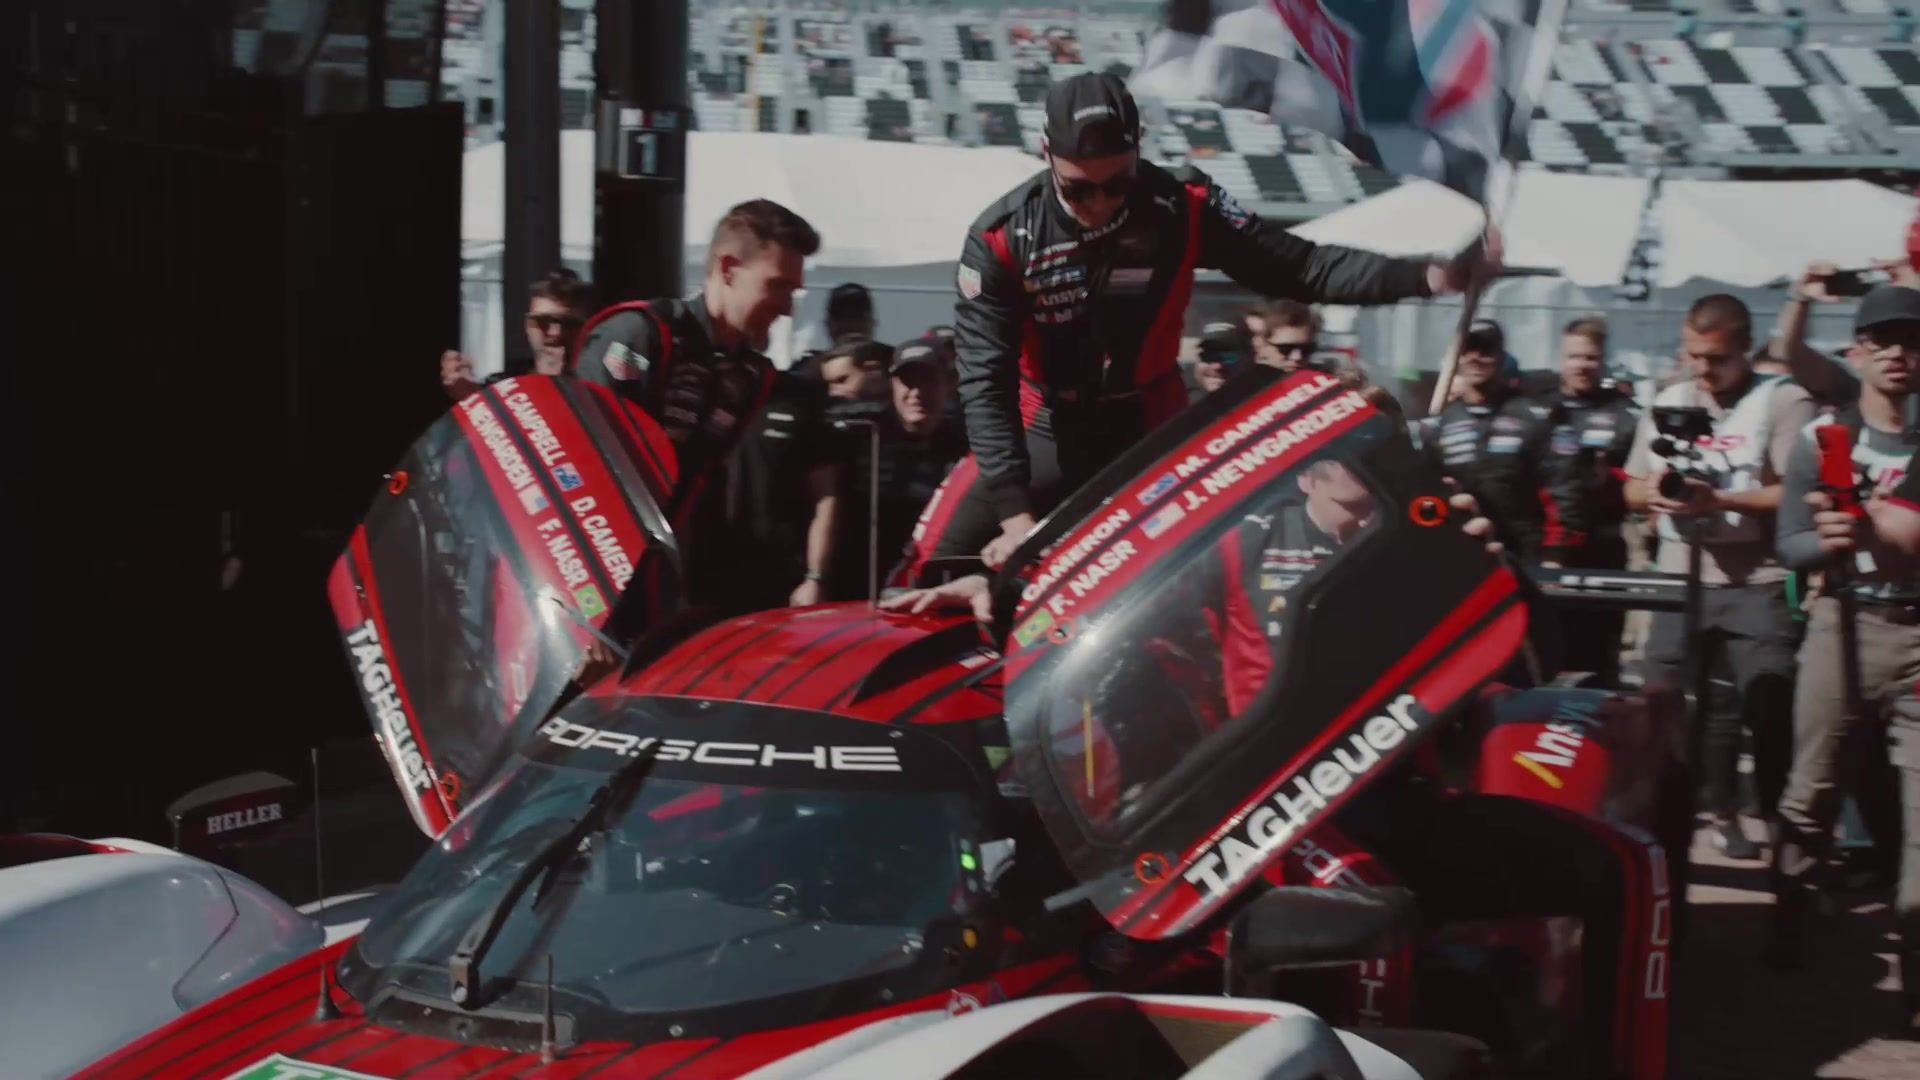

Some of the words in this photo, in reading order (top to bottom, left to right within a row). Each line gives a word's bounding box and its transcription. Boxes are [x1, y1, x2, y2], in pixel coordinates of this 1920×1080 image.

[634, 132, 657, 175] 1
[504, 393, 566, 467] CAMPBELL
[466, 402, 536, 491] NEWGARDEN
[546, 534, 590, 590] NASR
[1022, 508, 1131, 602] CAMERON
[1205, 375, 1340, 455] CAMPBELL
[1069, 540, 1138, 597] NASR
[1201, 390, 1368, 495] NEWGARDEN
[537, 717, 902, 772] PORSCHE
[206, 802, 283, 835] HELLER
